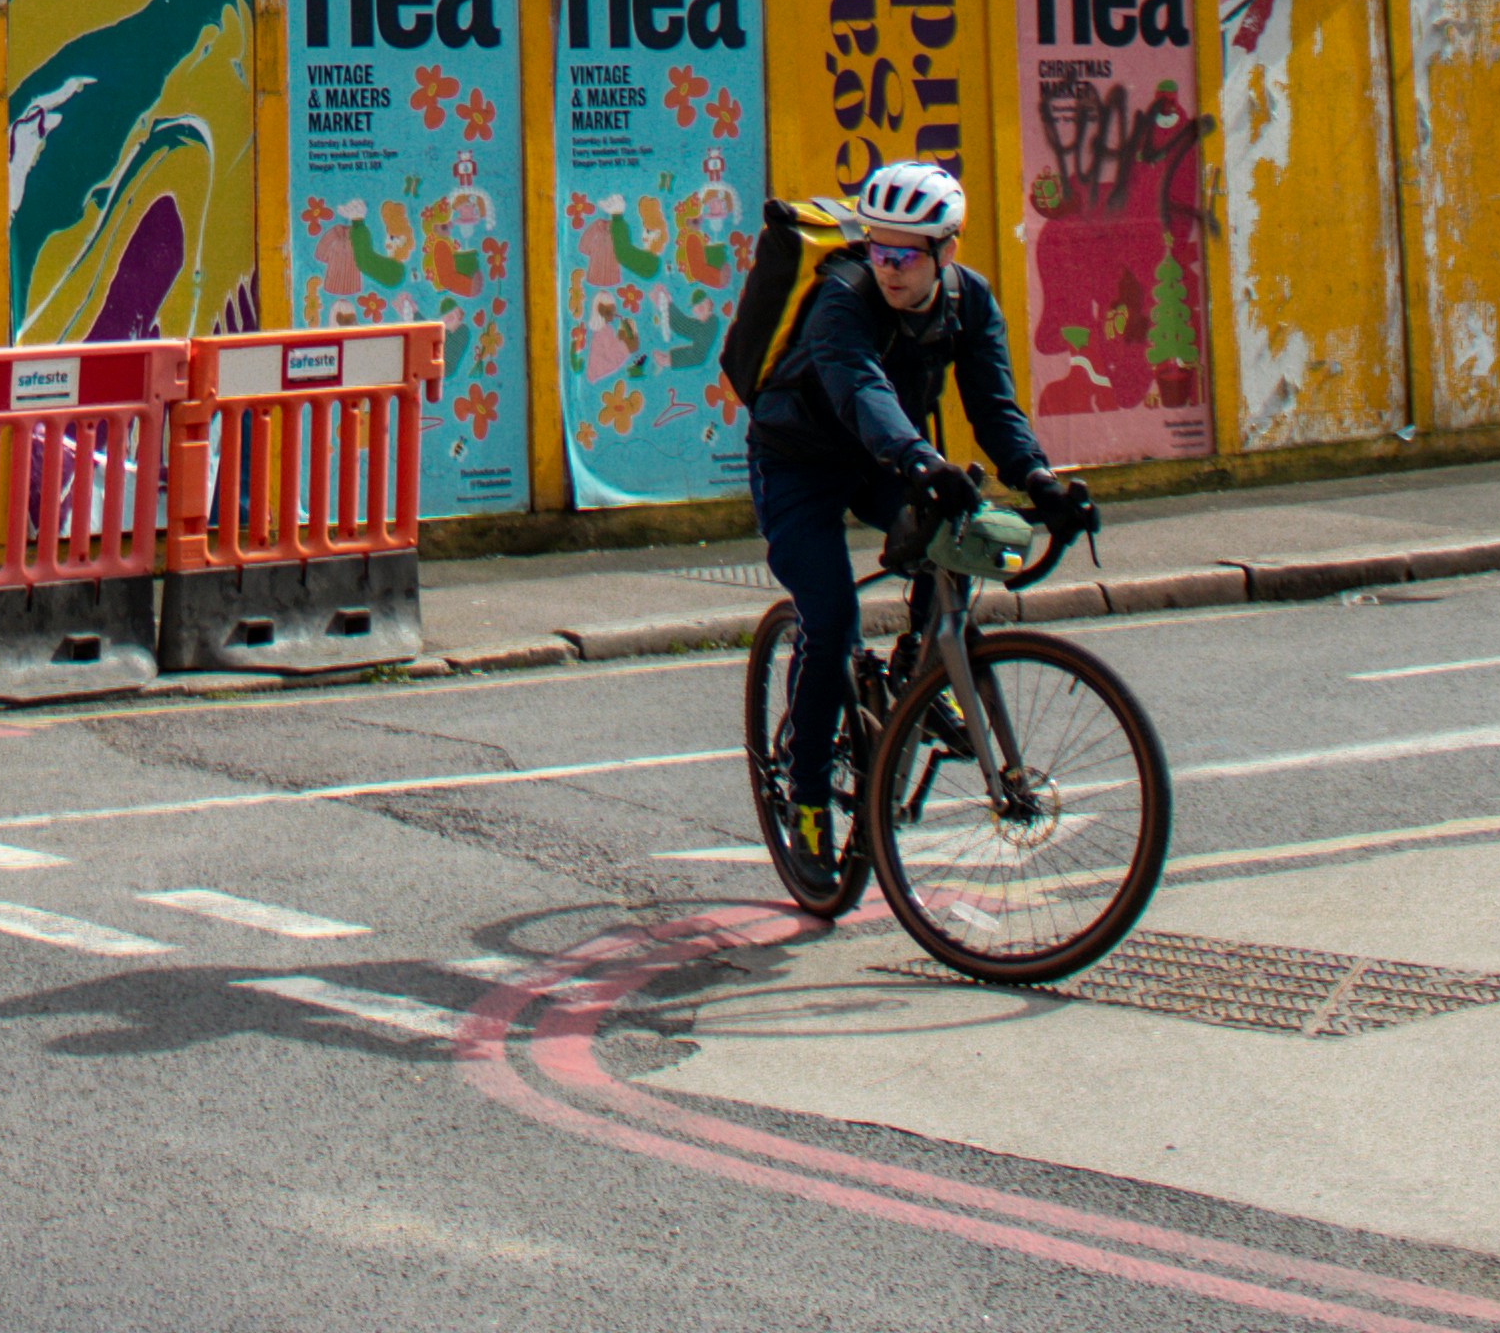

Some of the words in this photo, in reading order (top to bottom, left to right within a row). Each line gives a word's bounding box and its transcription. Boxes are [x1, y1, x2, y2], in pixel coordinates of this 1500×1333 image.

[307, 65, 374, 84] VINTAGE
[570, 65, 631, 84] VINTAGE
[1038, 59, 1112, 79] CHRISTMAS
[308, 89, 321, 109] &
[326, 88, 391, 109] MAKERS
[572, 89, 583, 107] &
[587, 88, 646, 108] MAKERS
[1039, 80, 1091, 100] MARKET
[308, 112, 374, 132] MARKET
[572, 110, 631, 131] MARKET
[289, 353, 336, 369] safesite
[17, 370, 69, 387] safesite
